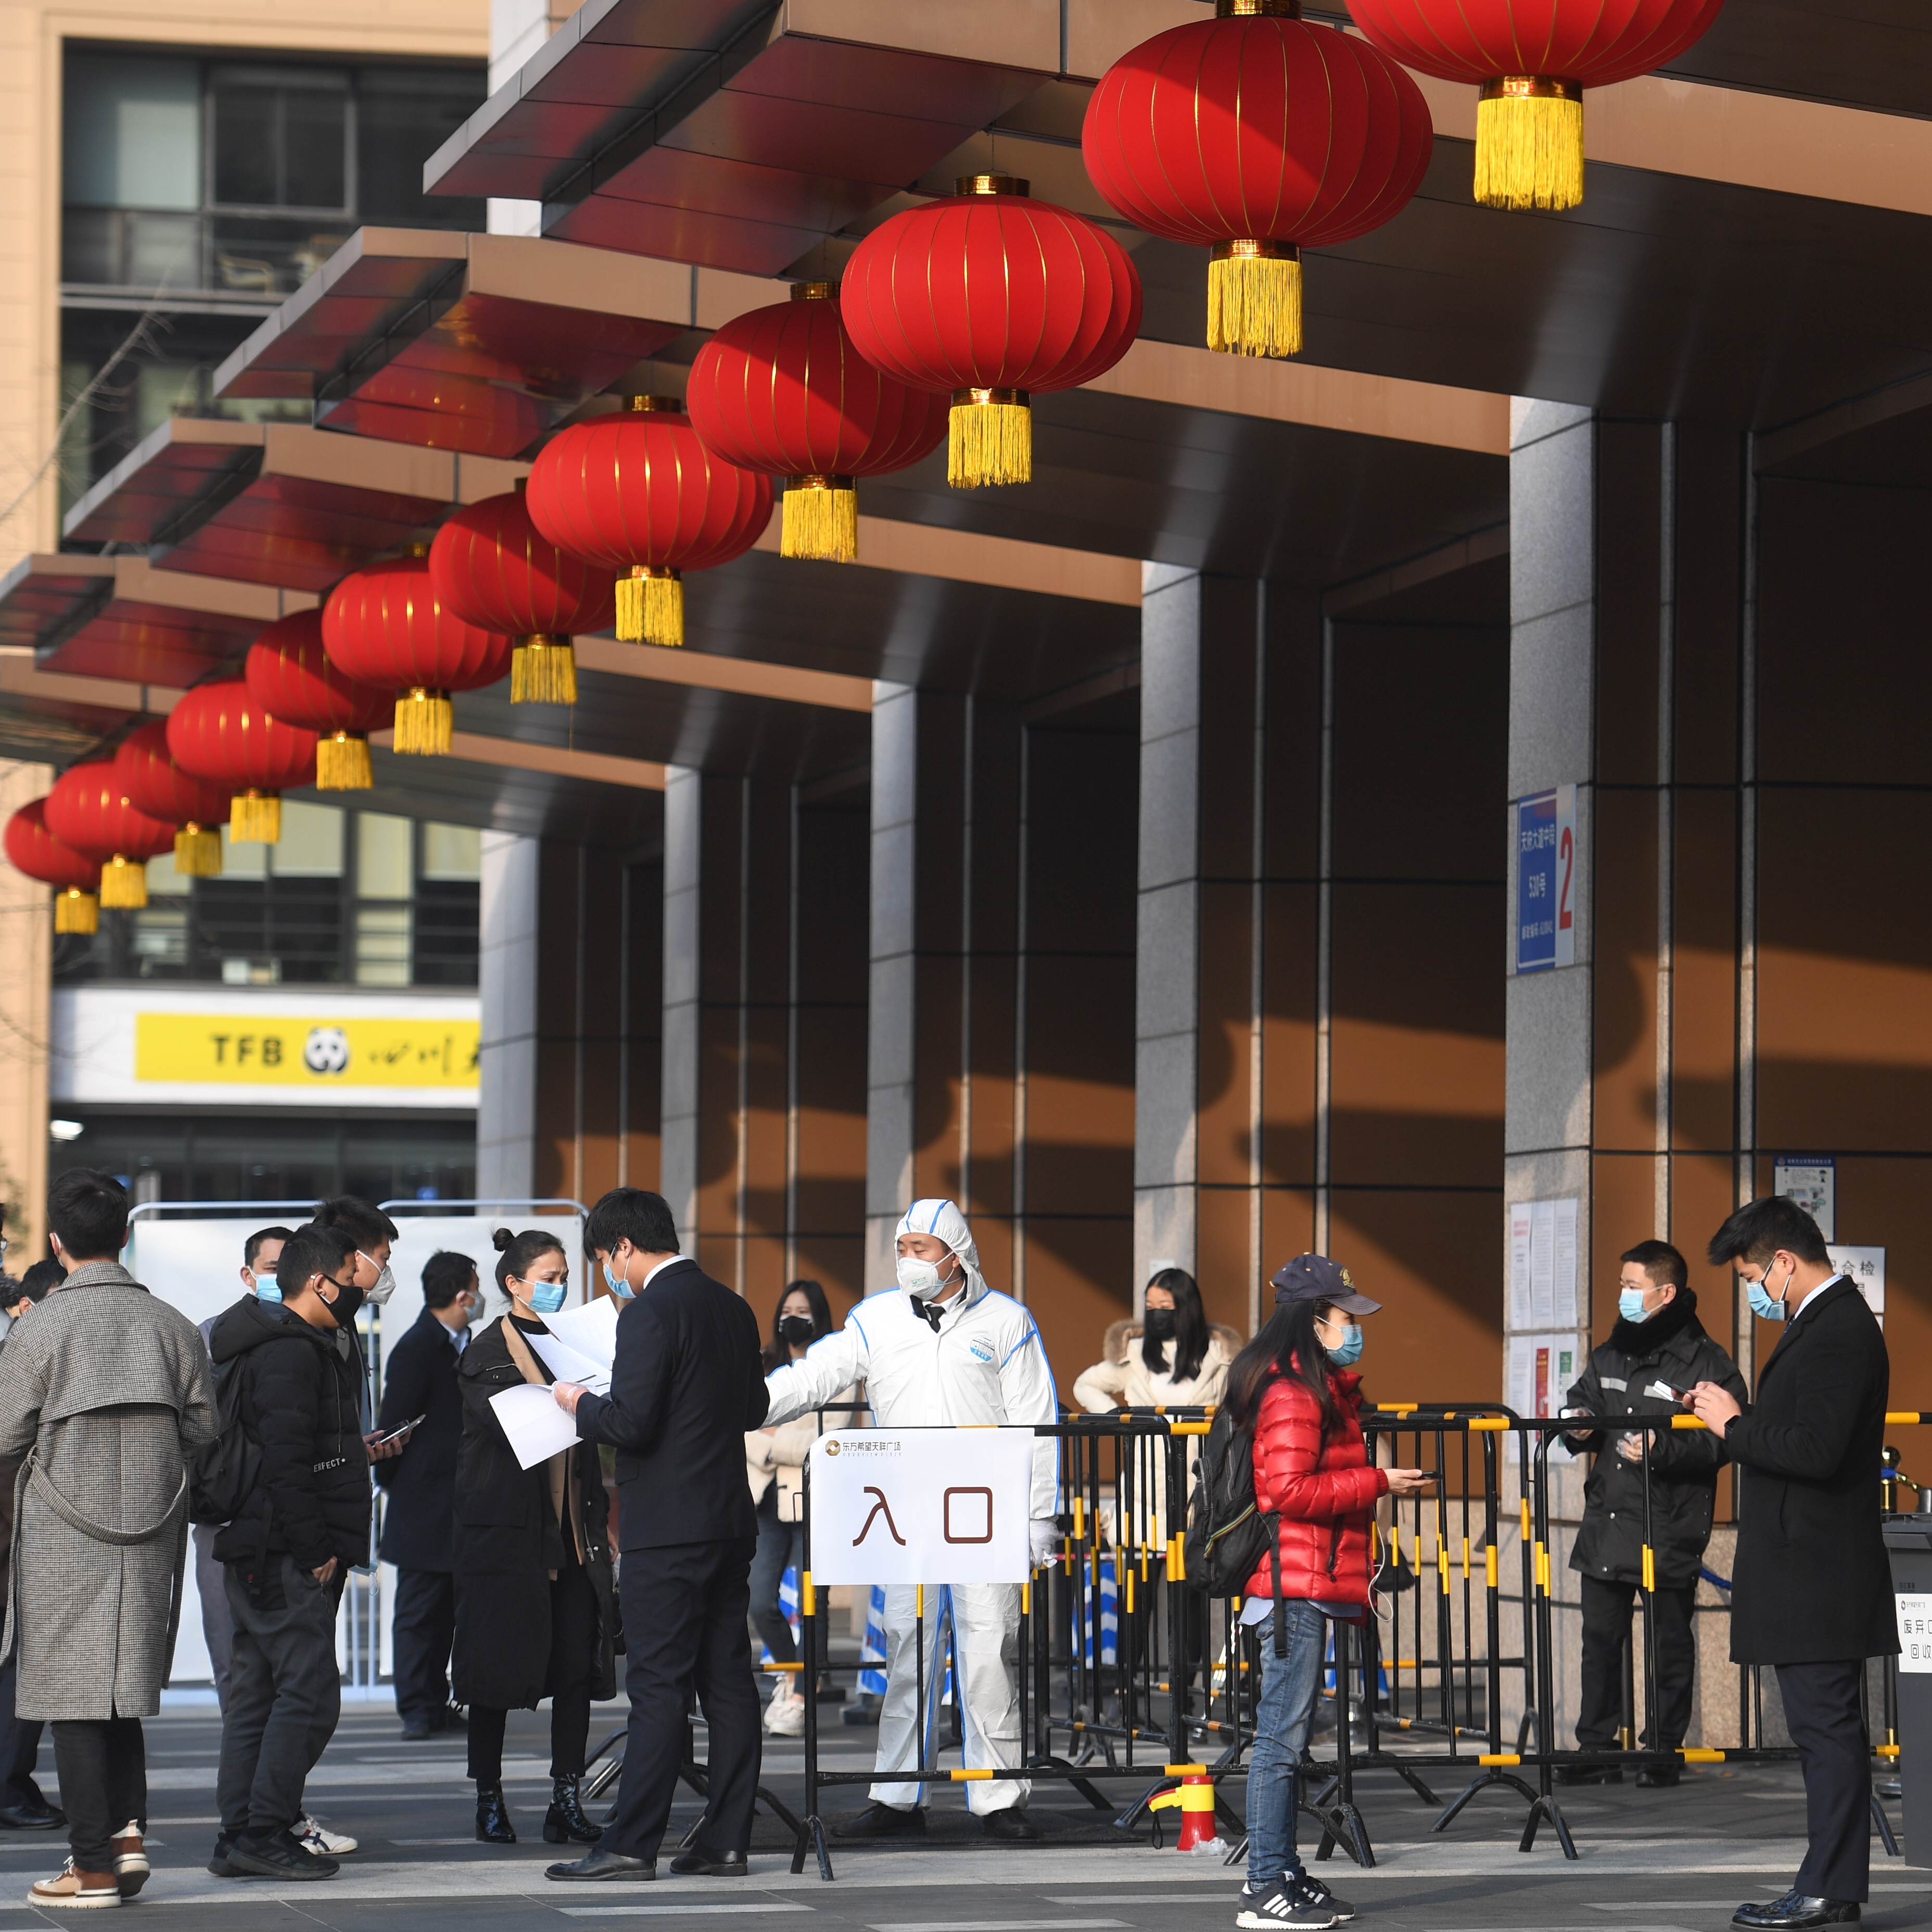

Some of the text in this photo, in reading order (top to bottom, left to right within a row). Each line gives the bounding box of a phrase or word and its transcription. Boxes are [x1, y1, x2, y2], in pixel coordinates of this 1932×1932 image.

[1560, 825, 1573, 931] 2
[211, 1035, 284, 1066] TFB
[842, 1441, 901, 1451] 东方希望天祥广场
[853, 1486, 993, 1547] 入口
[1910, 1644, 1931, 1659] 回收
